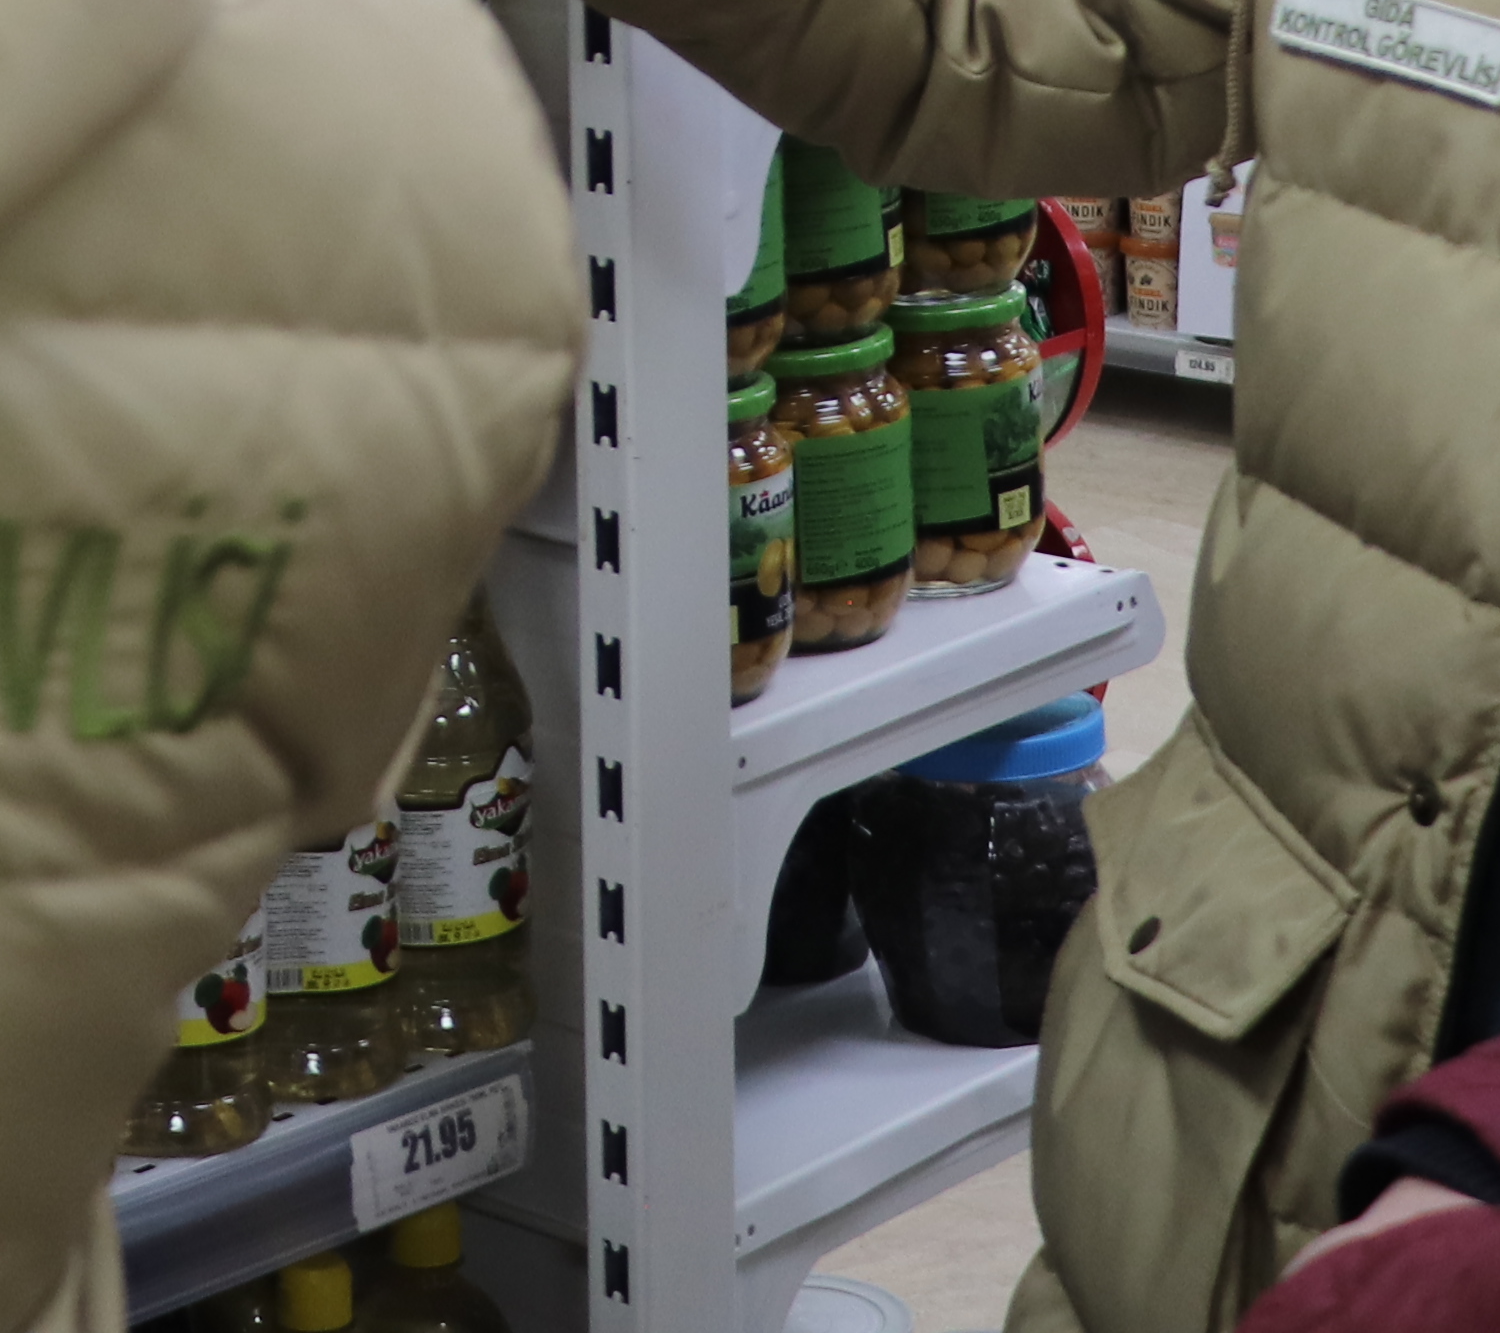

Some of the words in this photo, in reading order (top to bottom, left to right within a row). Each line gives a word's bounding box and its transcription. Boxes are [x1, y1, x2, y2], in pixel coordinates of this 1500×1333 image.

[1278, 7, 1370, 52] KONTROL
[1064, 205, 1104, 219] INDIK
[1132, 211, 1173, 228] FINDIK
[1130, 299, 1170, 313] FINDIK
[402, 1108, 476, 1174] 21.95
